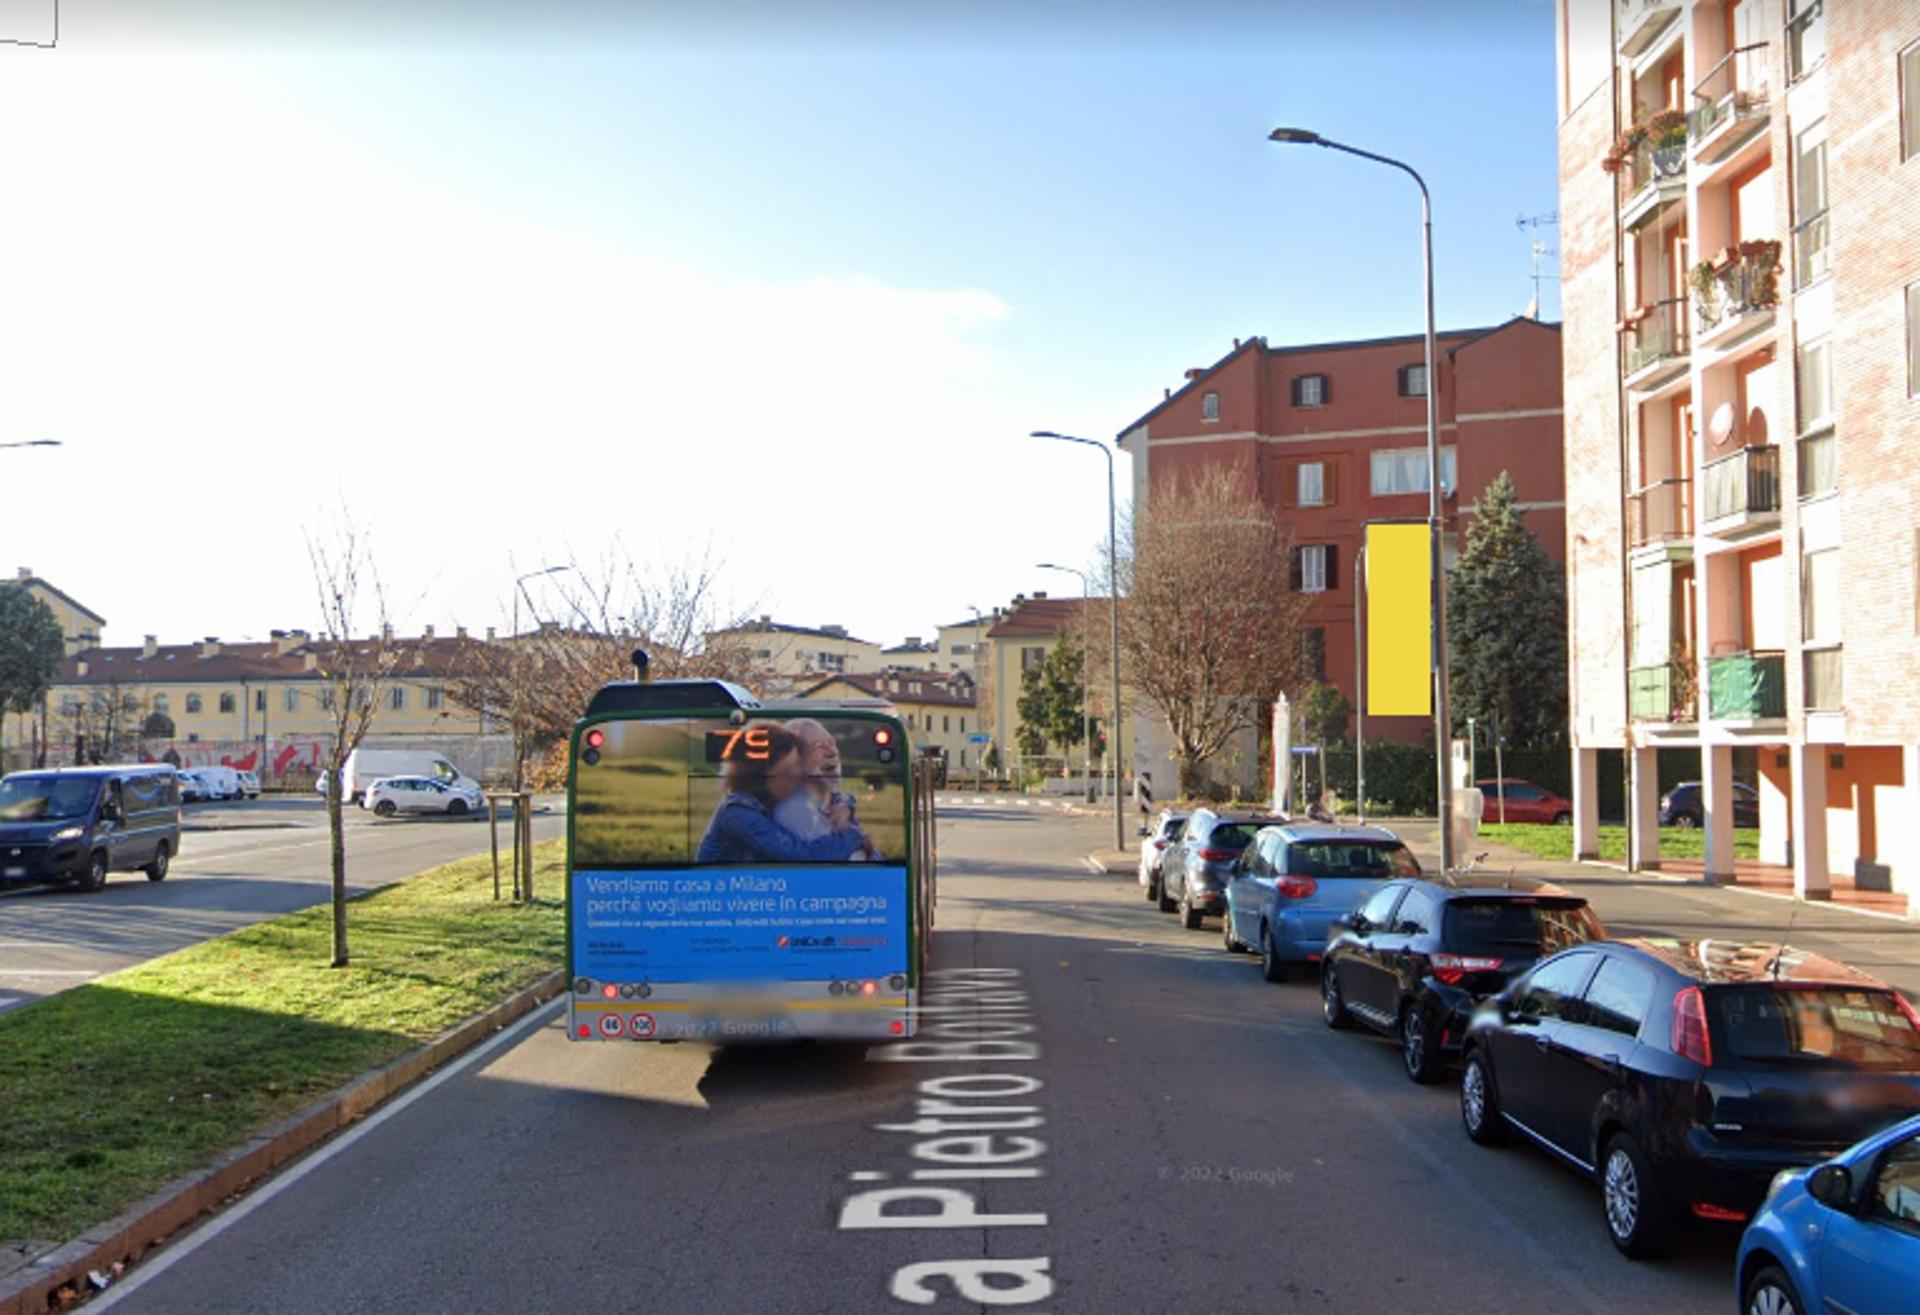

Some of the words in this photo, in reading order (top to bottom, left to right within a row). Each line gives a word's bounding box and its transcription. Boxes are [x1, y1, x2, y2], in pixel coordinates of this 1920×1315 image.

[586, 876, 669, 893] Vendiamo
[674, 880, 711, 893] casa
[715, 880, 726, 892] a
[729, 875, 787, 892] Milano
[586, 896, 641, 916] perché
[646, 896, 722, 915] vogliamo
[726, 896, 775, 911] vivere
[779, 896, 796, 911] in
[799, 896, 888, 914] campagna
